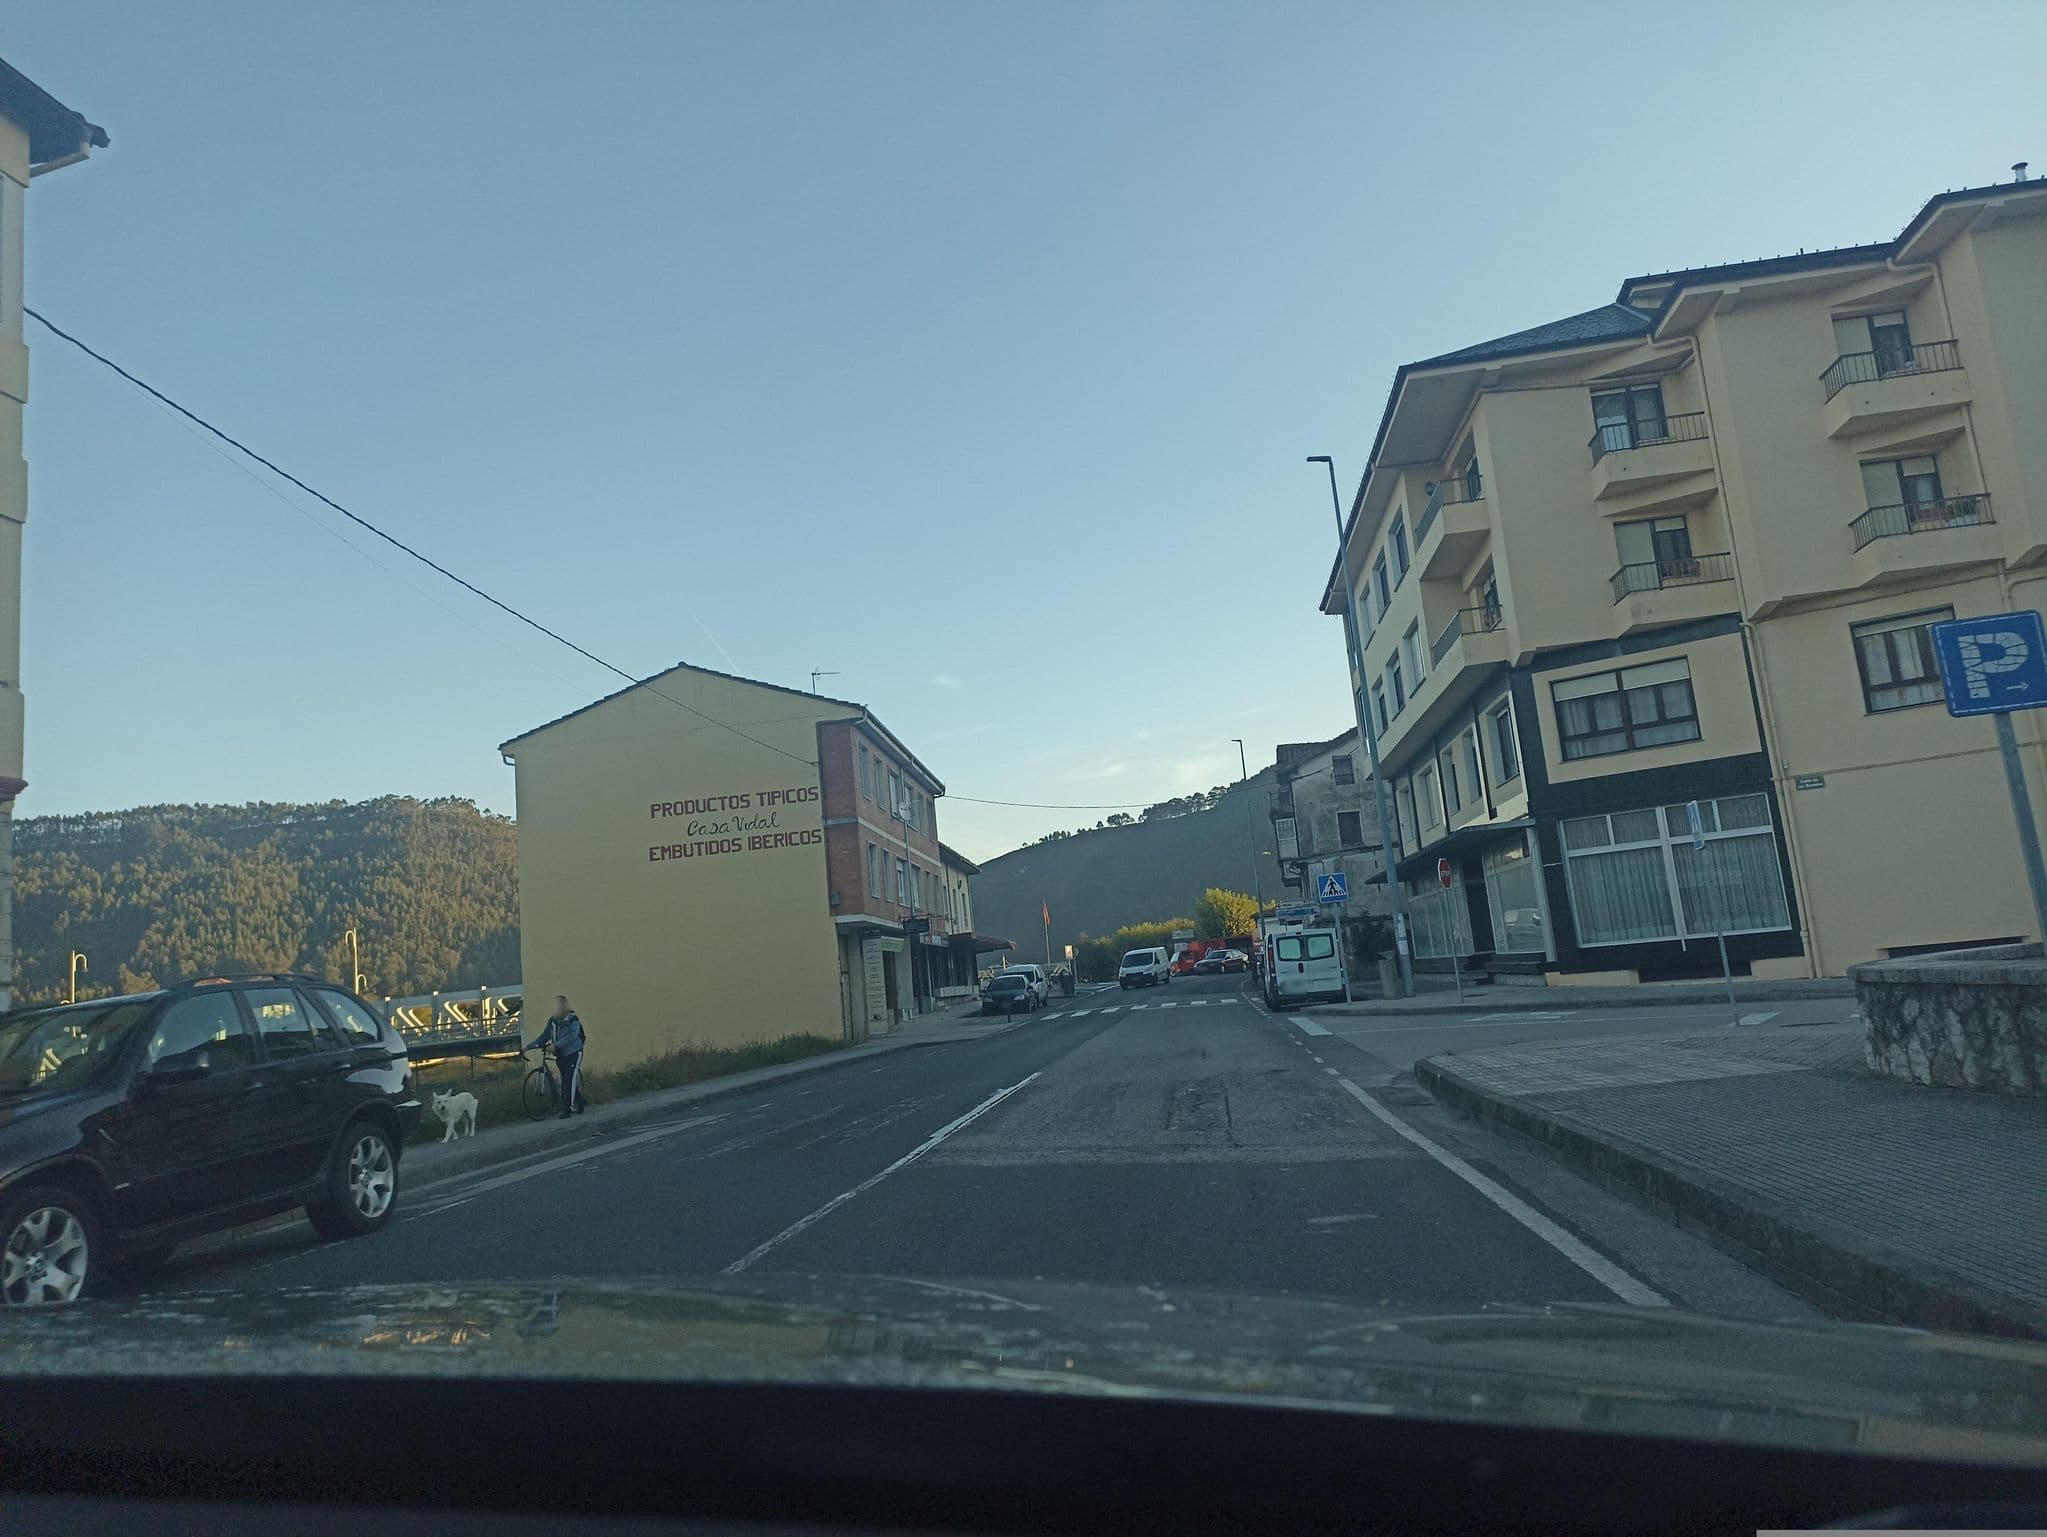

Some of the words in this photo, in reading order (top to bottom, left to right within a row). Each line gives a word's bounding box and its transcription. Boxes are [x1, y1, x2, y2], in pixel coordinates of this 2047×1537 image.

[1957, 631, 2029, 699] P
[650, 793, 751, 819] PRODUCTOS
[756, 786, 819, 807] TIPICOS
[687, 820, 730, 837] Casa
[732, 811, 781, 831] Vidal
[649, 837, 743, 862] EMBUTIDOS
[748, 828, 823, 851] IBERICOS
